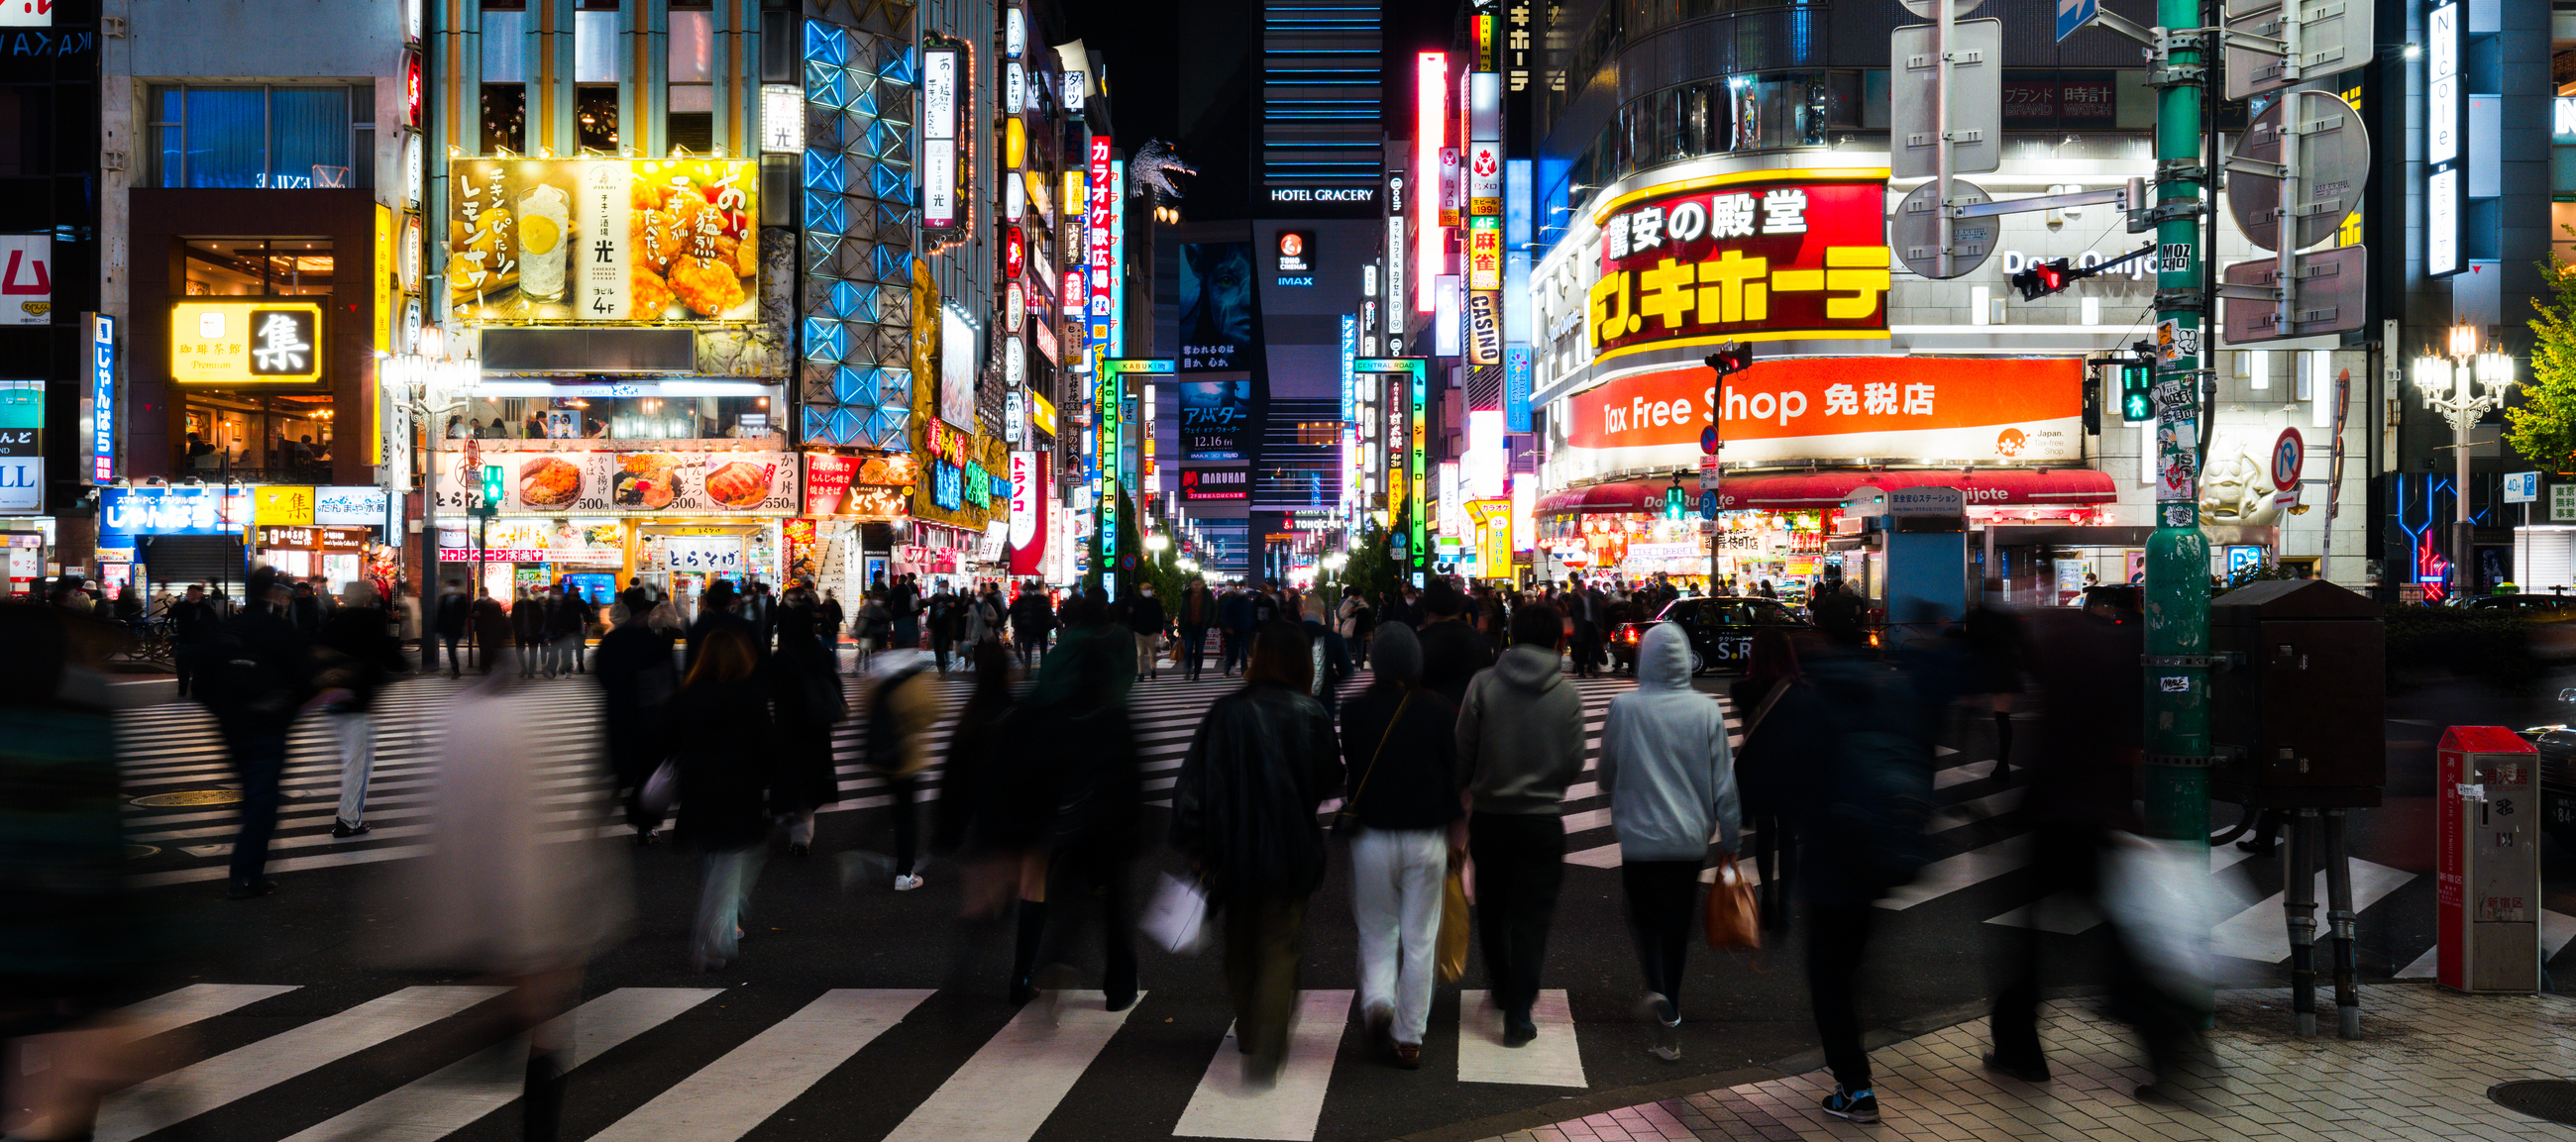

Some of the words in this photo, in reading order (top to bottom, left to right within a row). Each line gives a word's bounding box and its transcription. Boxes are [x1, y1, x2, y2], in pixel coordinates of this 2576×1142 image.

[1068, 73, 1079, 105] ダーツ
[2437, 15, 2449, 146] Nicole
[2004, 87, 2053, 103] ブランド
[2064, 86, 2112, 103] 時計
[2005, 103, 2052, 116] BRAND
[2064, 103, 2112, 116] WATCH
[774, 128, 792, 148] 光
[933, 194, 944, 206] 光
[1271, 189, 1313, 201] HOTEL
[1314, 189, 1374, 201] GRACERY
[1444, 179, 1454, 208] 鳥メロ
[668, 176, 690, 242] チキンが
[1092, 142, 1109, 289] カラオケ歌広場
[489, 168, 514, 280] チキンにぴったり!
[1475, 218, 1494, 229] 4F
[1608, 188, 1808, 260] 驚安の殿堂
[2438, 178, 2447, 267] ミステリアス
[461, 174, 488, 309] レモンサワー
[643, 207, 667, 265] たべたい。
[695, 207, 722, 270] 猛烈に
[594, 240, 614, 263] 光
[1474, 233, 1496, 272] 麻雀
[2162, 245, 2191, 259] MOZ
[2, 250, 51, 295] ム
[592, 287, 614, 296] 当ビル
[592, 297, 615, 315] 4F
[1470, 295, 1498, 361] CASINO
[179, 343, 242, 356] 珈琲茶館
[253, 313, 310, 371] 集
[1183, 346, 1215, 355] 奪われるのは
[191, 361, 232, 370] Premium
[1070, 355, 1082, 363] 3F
[97, 348, 111, 453] じゃんぱら
[1824, 382, 1936, 416] 免税店
[1183, 406, 1248, 426] アバター
[1604, 403, 1628, 436] Tax
[1633, 396, 1692, 430] Free
[1702, 385, 1808, 427] Shop
[1105, 390, 1115, 483] GODZILLA
[1389, 412, 1402, 449] 甘太郎
[1068, 427, 1078, 454] 海の家
[1195, 436, 1222, 447] 12.16
[586, 457, 594, 476] そば
[810, 461, 851, 471] お好み焼き
[1414, 401, 1425, 528] ゴジラロード
[596, 455, 608, 495] かき揚げ
[681, 456, 691, 496] ラーメン
[692, 455, 702, 496] とんこつ
[780, 454, 794, 495] かつ丼
[810, 473, 851, 483] もんじゃ焼き
[1202, 471, 1246, 484] MARUHAN
[2527, 476, 2536, 486] P
[808, 485, 842, 495] 焼きそば
[1013, 457, 1025, 512] トラノコ
[2507, 477, 2522, 494] 40分
[2554, 485, 2576, 497] 東京
[286, 492, 310, 520] 集
[579, 497, 609, 511] 500円
[672, 496, 702, 510] 500円
[765, 496, 796, 510] 550円
[808, 497, 825, 507] ピザ
[849, 486, 907, 512] とらぢゅう
[1481, 503, 1510, 512] カラオケ
[1892, 494, 1958, 503] 安全安心ステーション
[2554, 497, 2576, 508] 無料
[107, 505, 213, 529] じゃんぱら
[321, 503, 384, 513] だんまや水産
[1105, 494, 1115, 539] ROAD
[2554, 508, 2576, 519] 事業
[1295, 520, 1320, 529] TOHO
[439, 550, 543, 561] キャンペーン実施中
[671, 551, 739, 569] とらそば
[2446, 757, 2456, 799] 消火器
[2482, 768, 2528, 785] 消火器
[2439, 872, 2463, 884] 新宿区
[2487, 896, 2523, 908] 新宿区
